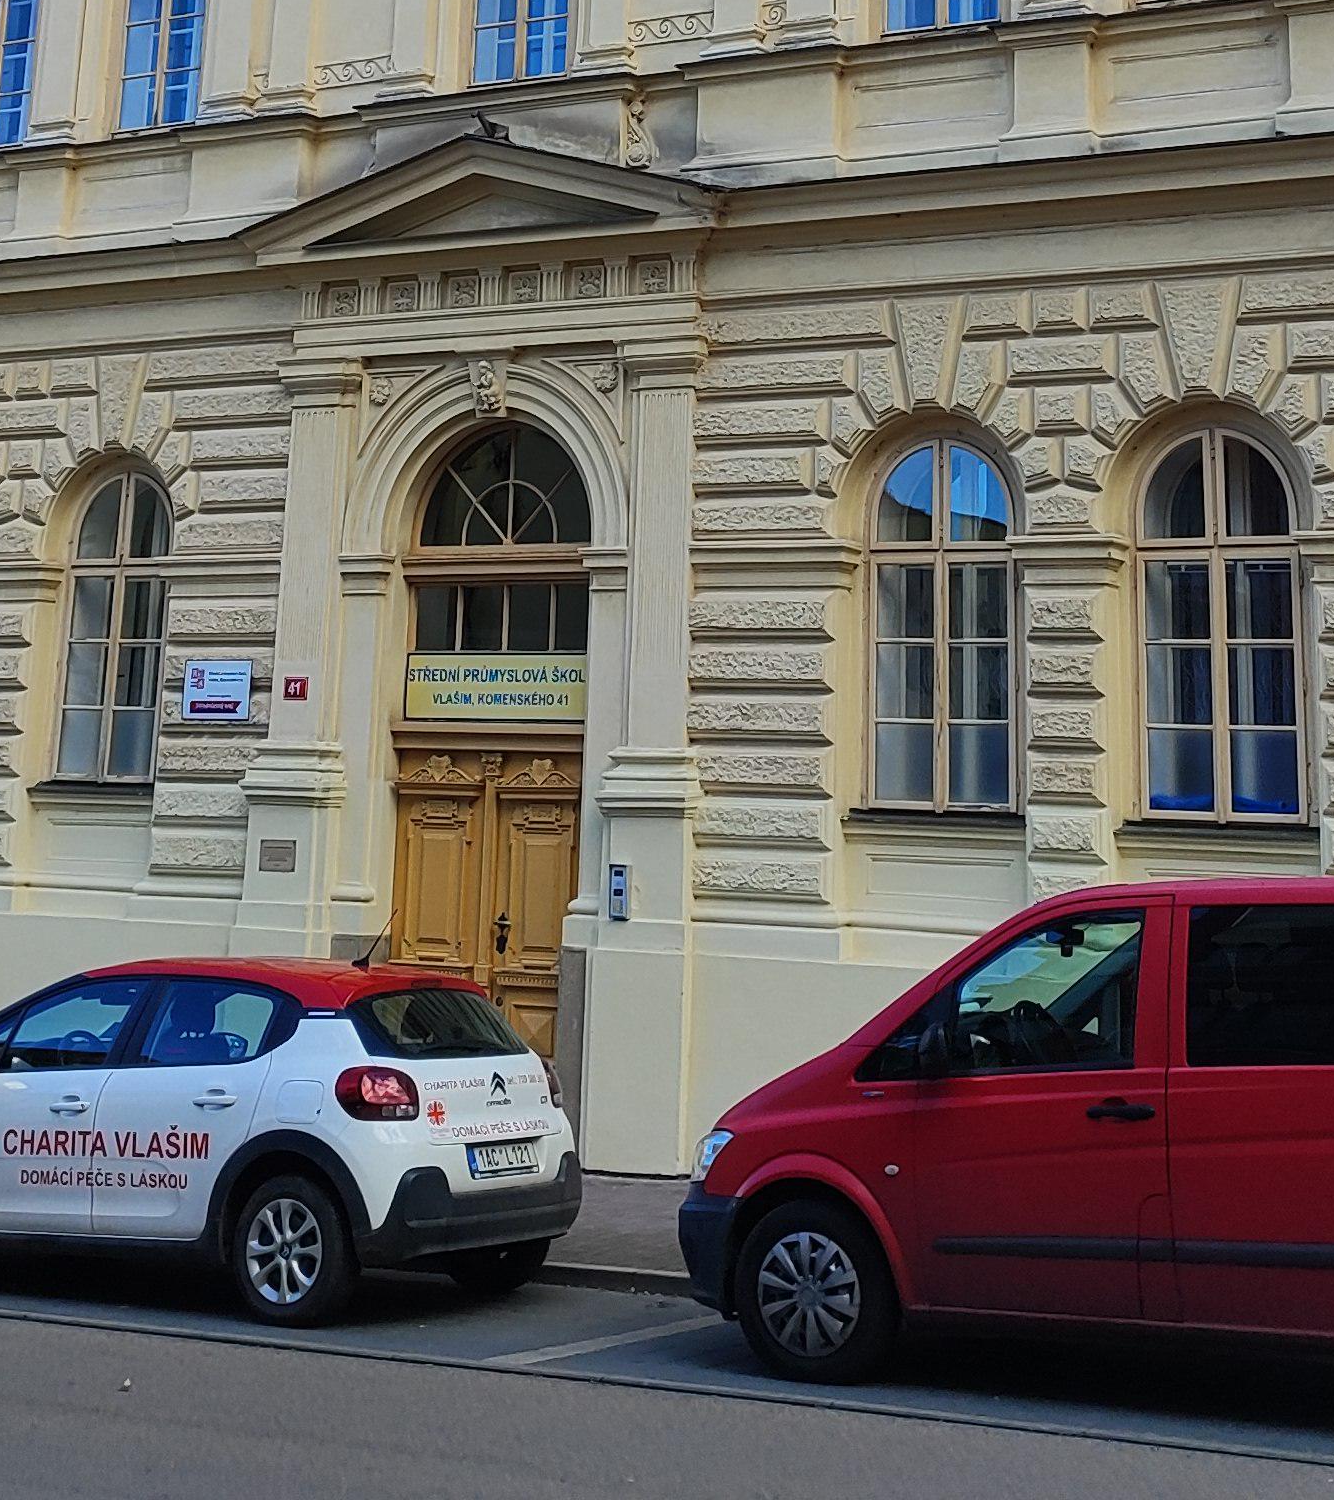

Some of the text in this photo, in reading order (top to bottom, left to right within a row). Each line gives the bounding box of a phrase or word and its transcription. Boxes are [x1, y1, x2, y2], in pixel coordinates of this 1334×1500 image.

[409, 665, 461, 683] STŘEDNÍ
[463, 665, 548, 683] PRŮMYSLOVÁ
[287, 681, 302, 696] 41
[477, 691, 555, 706] KOMENSKÉHO
[556, 694, 569, 706] 41
[3, 1125, 210, 1160] CHARITA VLAŠIM
[479, 1145, 532, 1168] 1AC L121
[20, 1166, 73, 1187] DOMÁCÍ
[117, 1172, 126, 1187] S
[130, 1169, 188, 1190] LÁSKOU
